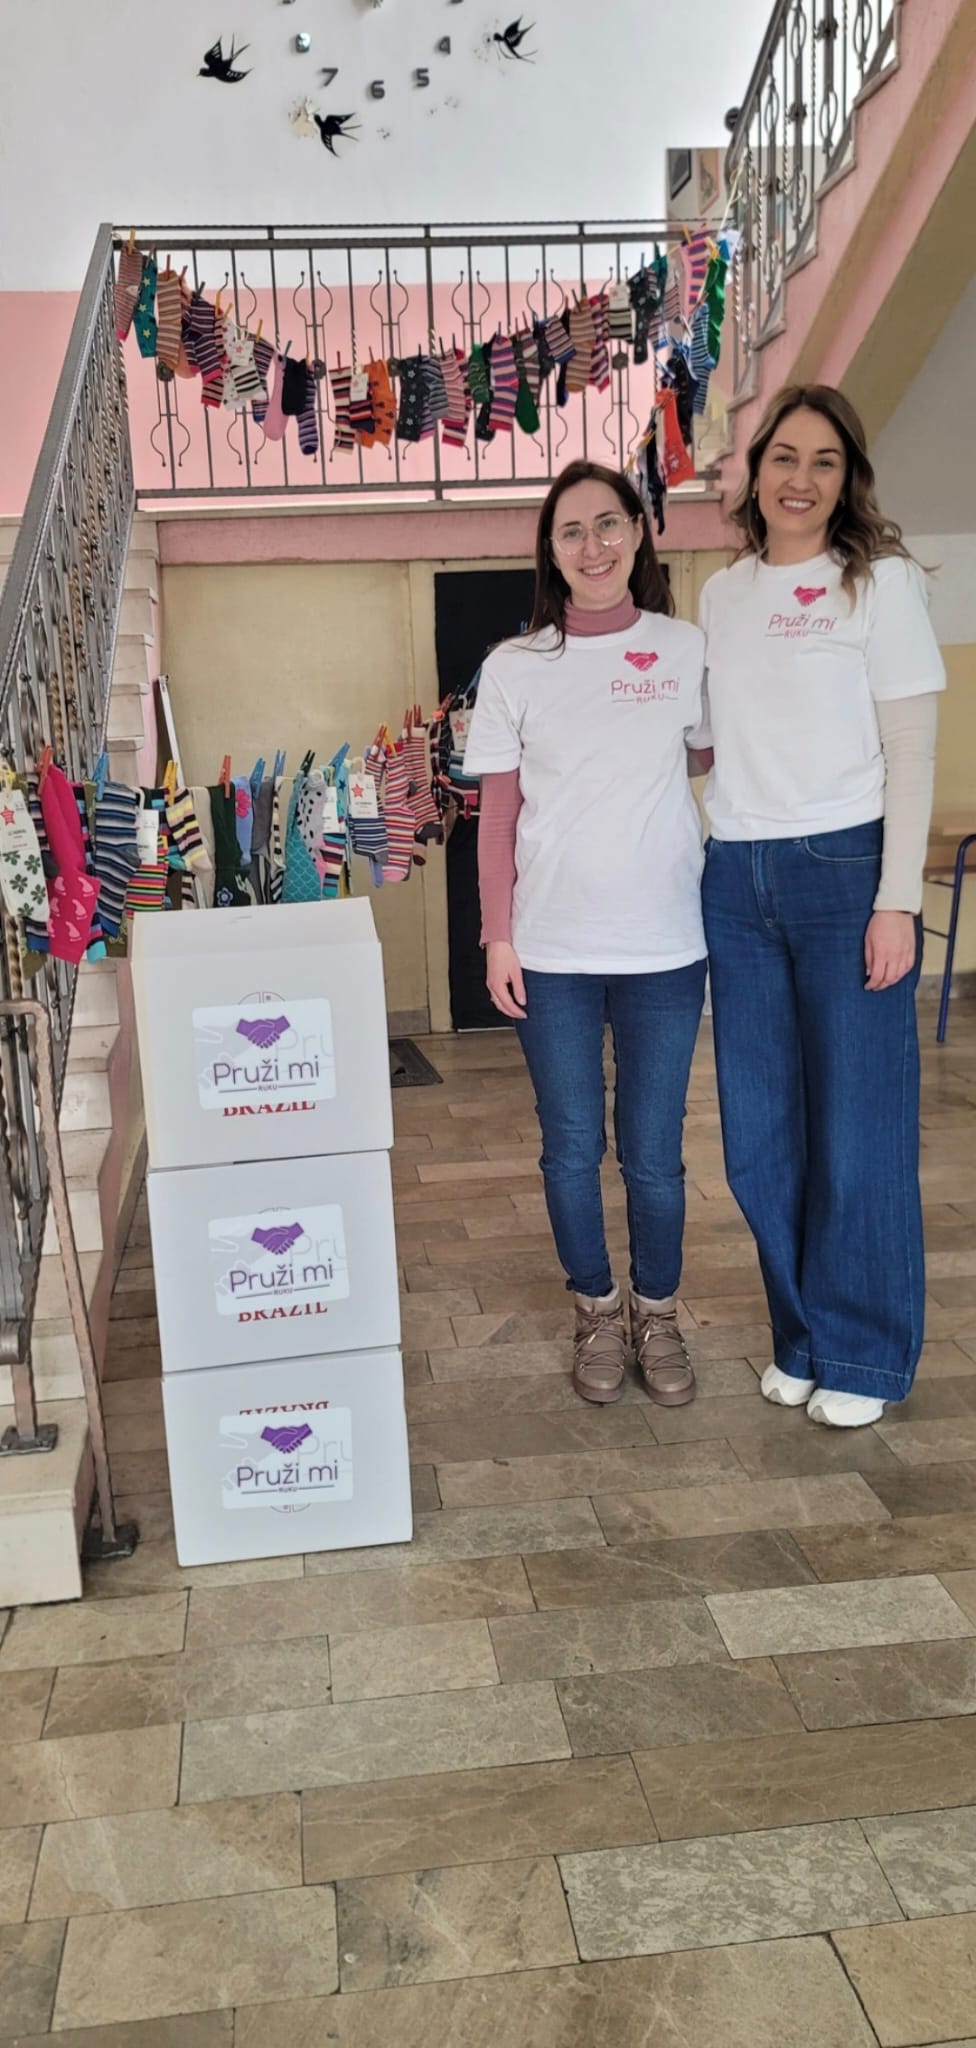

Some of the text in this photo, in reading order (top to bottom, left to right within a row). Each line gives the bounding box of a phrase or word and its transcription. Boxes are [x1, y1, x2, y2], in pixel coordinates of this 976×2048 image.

[438, 36, 451, 54] 4
[321, 67, 339, 86] 7
[415, 67, 430, 87] 5
[370, 80, 385, 99] 6
[768, 613, 838, 631] Pruži mi
[611, 676, 680, 696] Pruži mi
[213, 1055, 320, 1086] Pruži mi
[257, 1084, 278, 1092] RUKU
[229, 1257, 333, 1293] Pruži mi
[236, 1459, 338, 1488] Pruži mi
